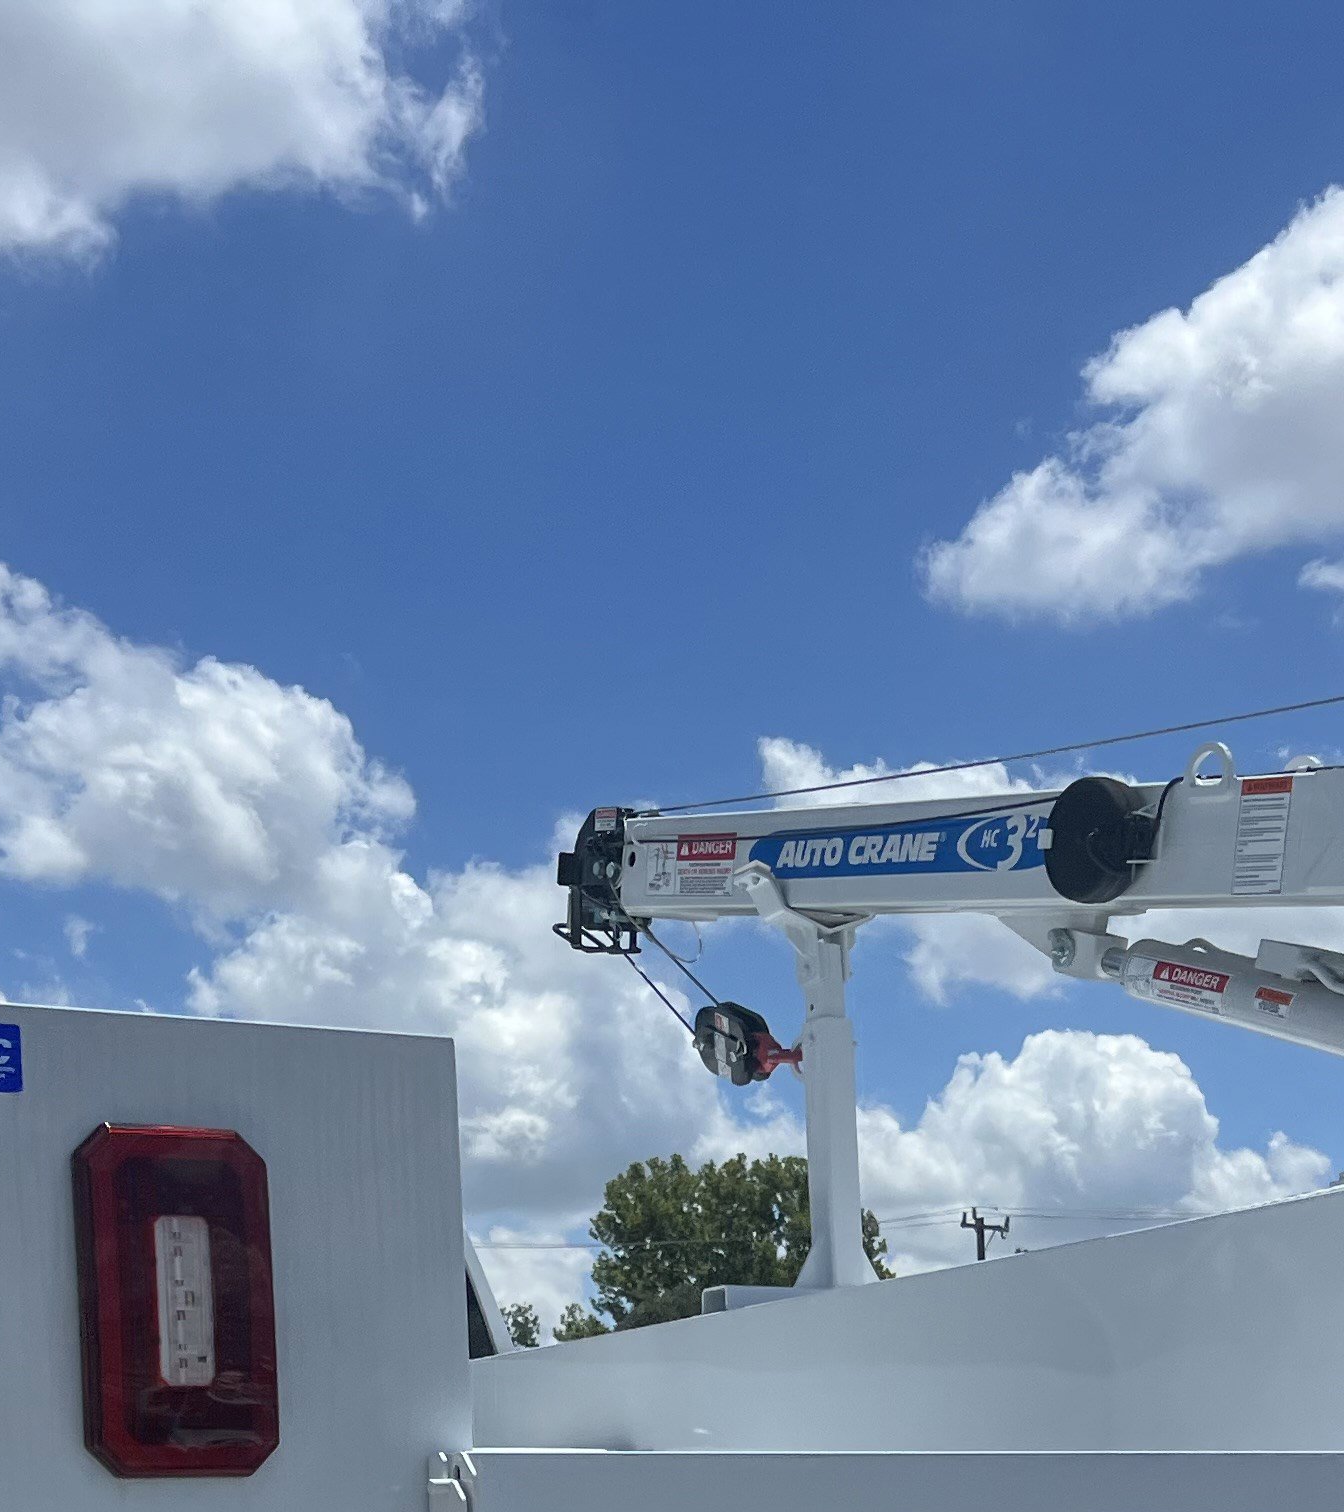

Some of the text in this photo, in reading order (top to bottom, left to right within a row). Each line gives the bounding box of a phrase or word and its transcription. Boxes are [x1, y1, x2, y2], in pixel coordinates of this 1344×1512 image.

[691, 840, 733, 854] DANGER
[980, 829, 1000, 848] HC
[776, 832, 940, 868] AUTO CRANE
[1171, 968, 1220, 988] DANGER
